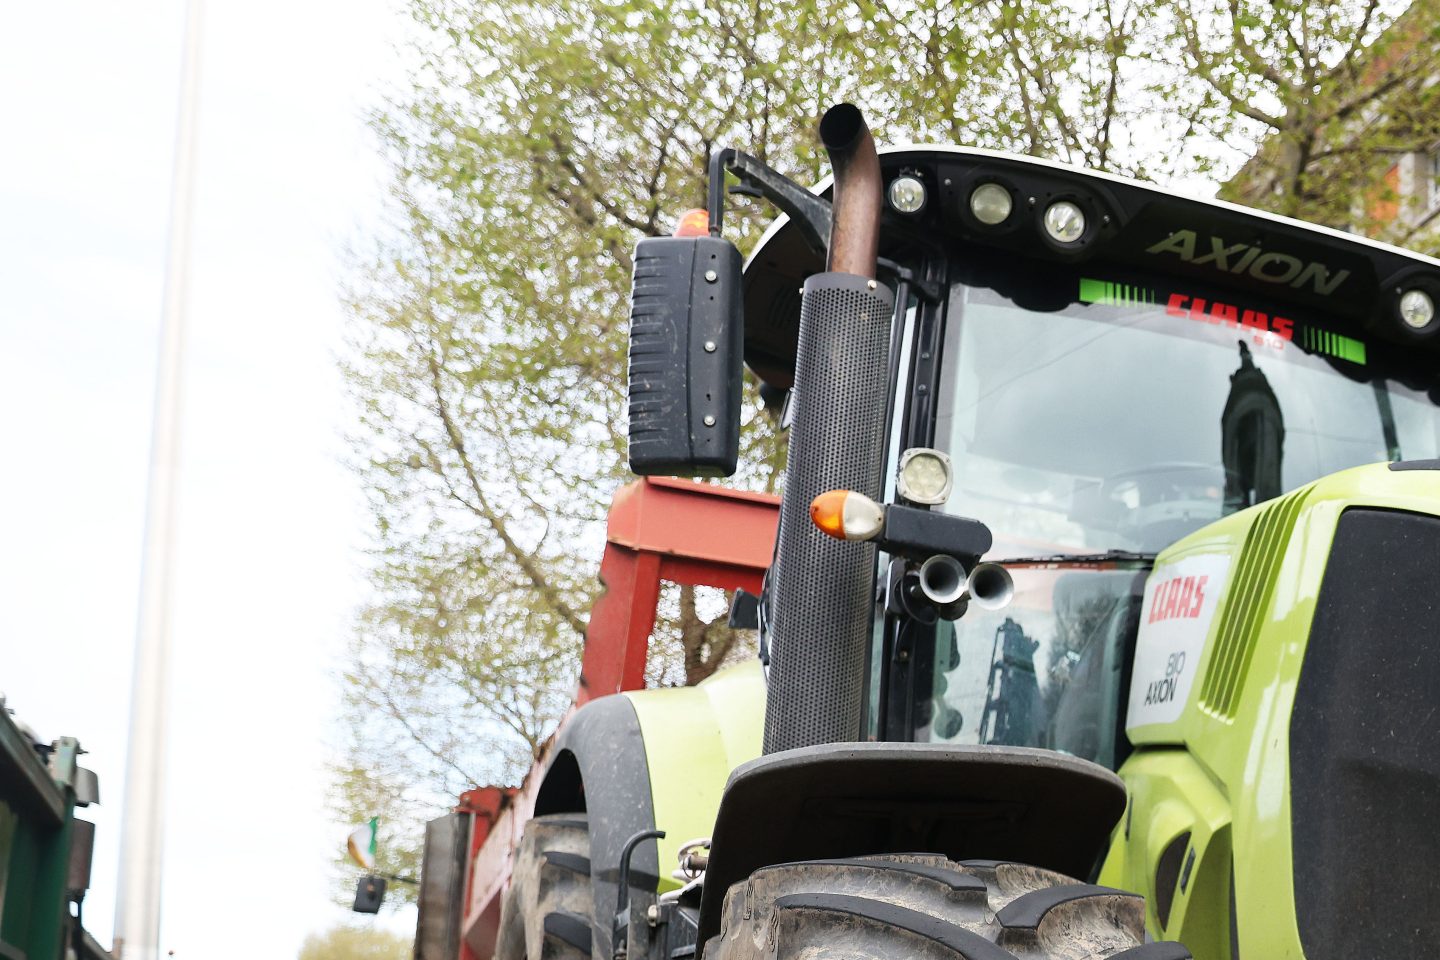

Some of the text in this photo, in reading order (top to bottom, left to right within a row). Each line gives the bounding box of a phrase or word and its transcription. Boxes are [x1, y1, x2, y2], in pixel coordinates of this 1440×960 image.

[1146, 229, 1350, 296] AXION
[1165, 293, 1294, 341] CLAAS
[1148, 575, 1209, 624] CLAAS
[1144, 677, 1178, 706] AXION
